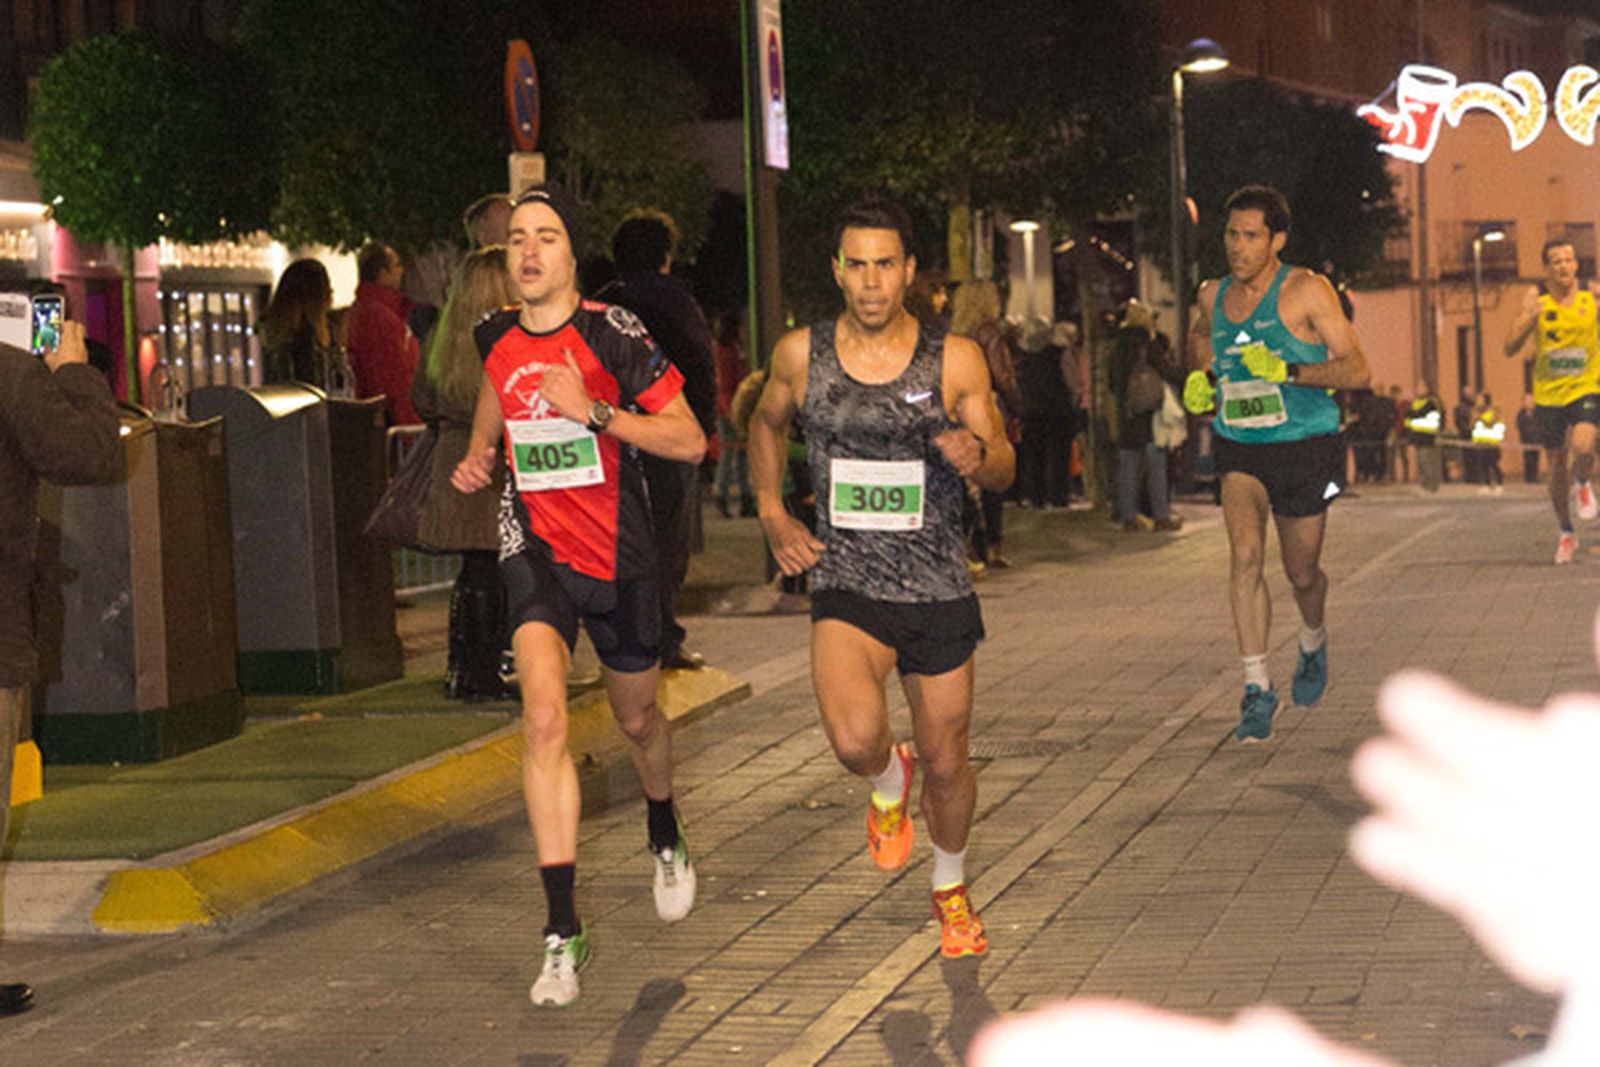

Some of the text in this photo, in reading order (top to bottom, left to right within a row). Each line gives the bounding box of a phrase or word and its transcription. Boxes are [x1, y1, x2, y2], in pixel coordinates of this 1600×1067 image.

[1240, 397, 1264, 417] 80
[527, 442, 579, 471] 405
[850, 485, 905, 512] 309
